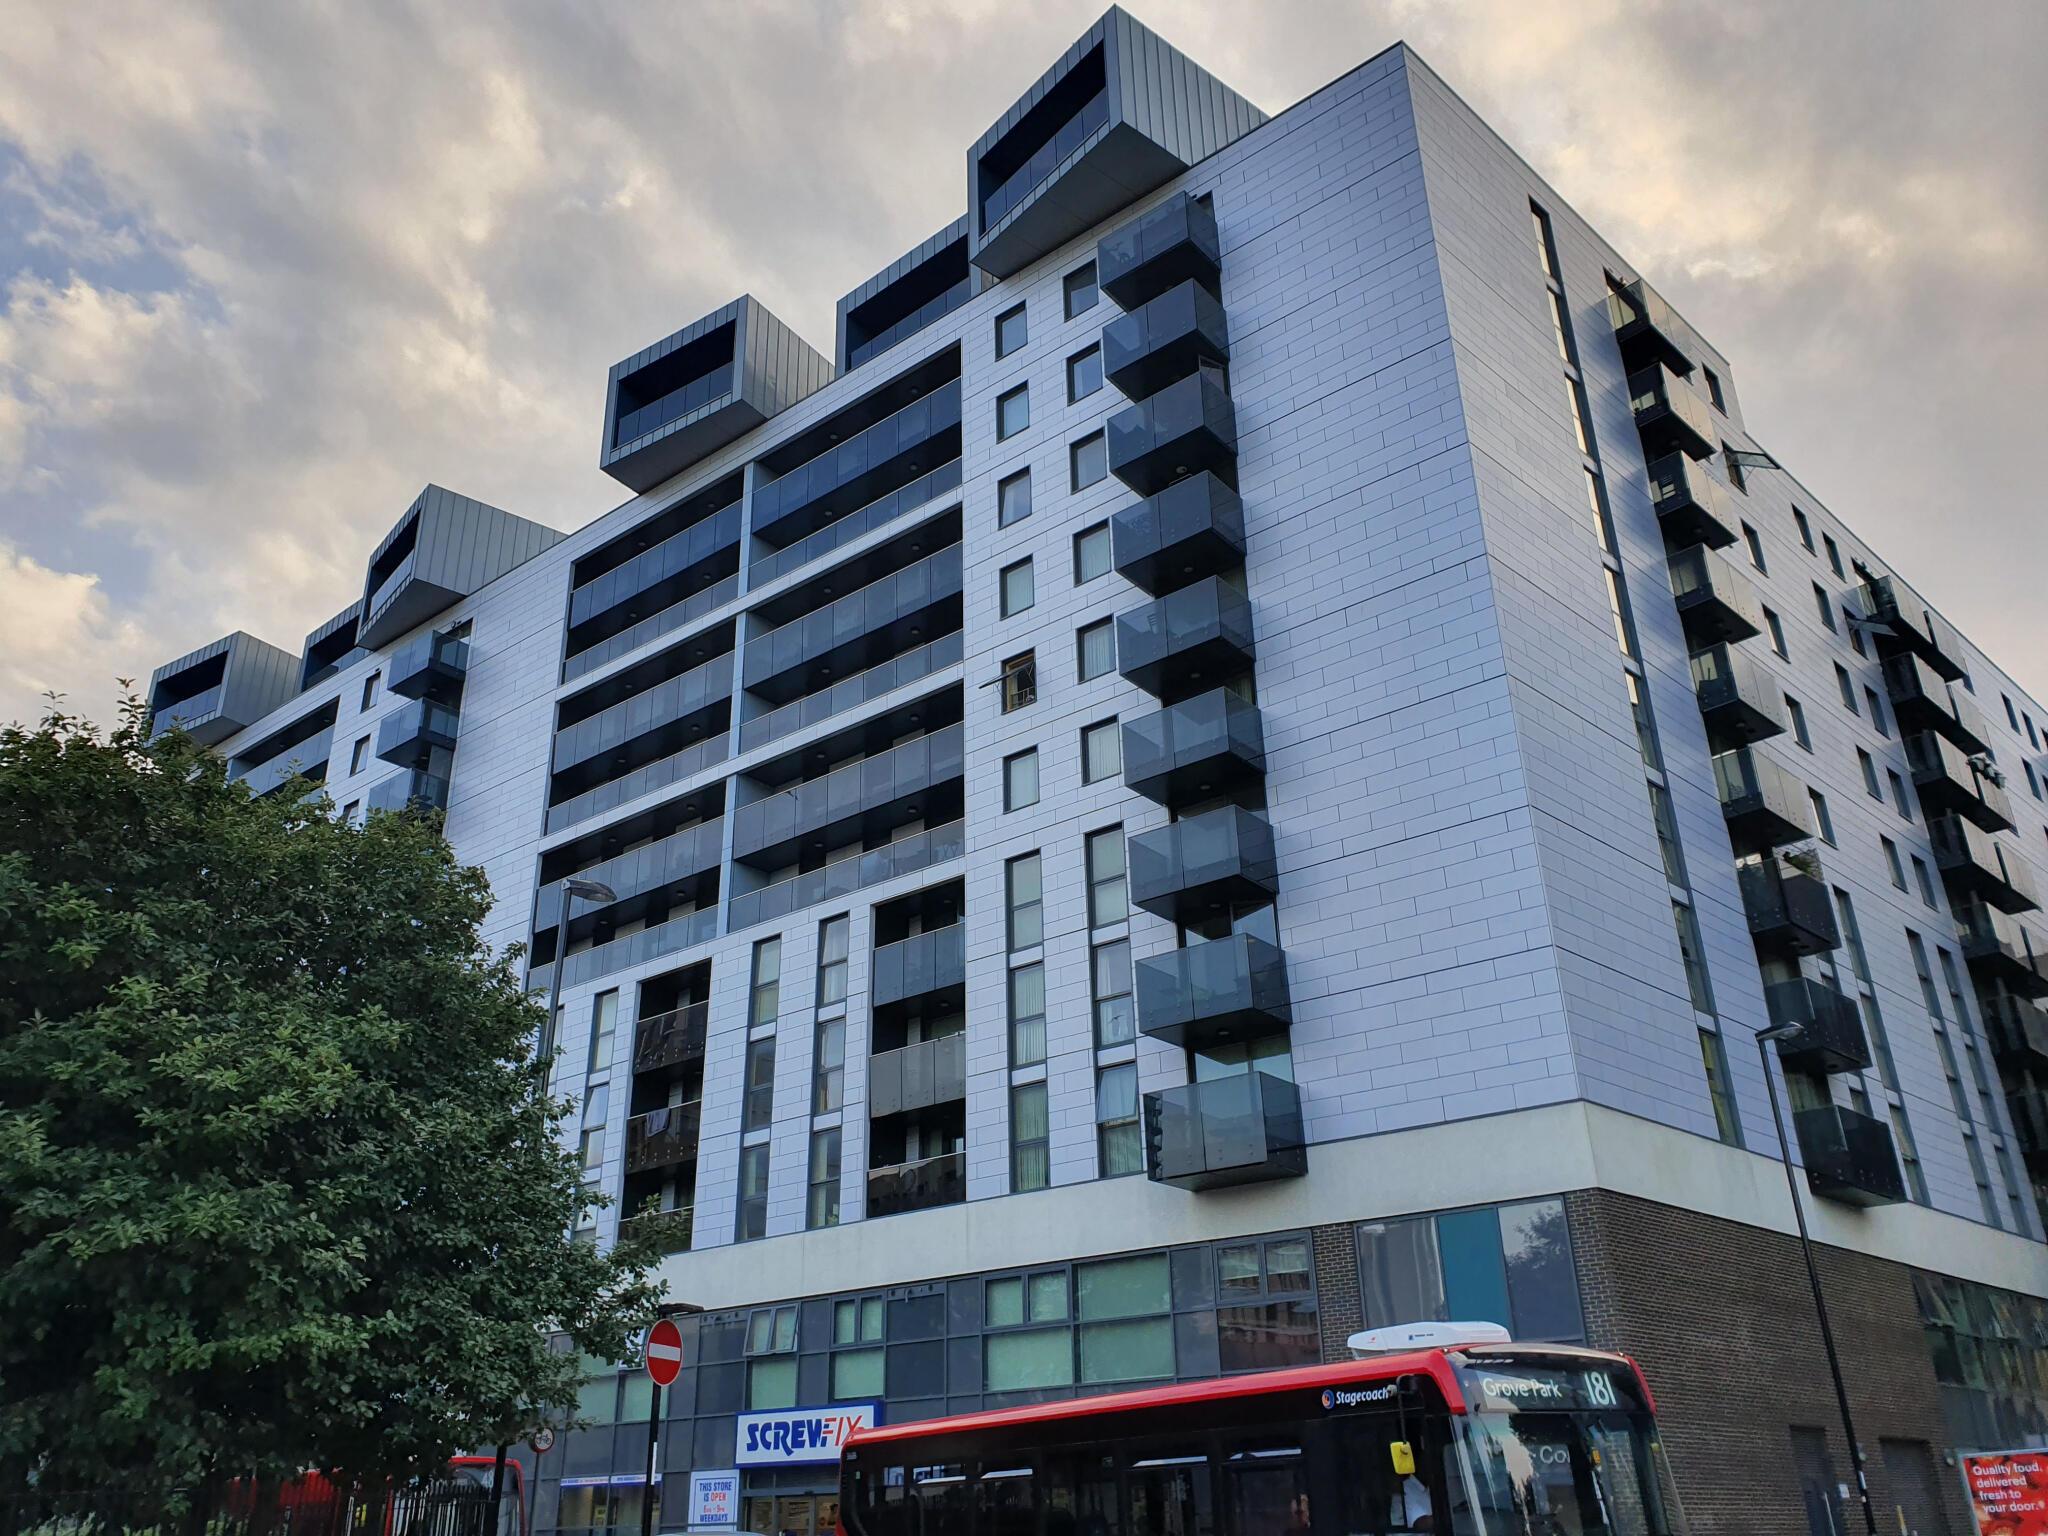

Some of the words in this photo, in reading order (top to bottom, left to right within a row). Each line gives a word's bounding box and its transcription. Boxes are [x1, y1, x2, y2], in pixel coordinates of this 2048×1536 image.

[1482, 1377, 1529, 1397] Grove
[1531, 1378, 1562, 1398] Park
[1584, 1370, 1616, 1405] 181
[1336, 1386, 1389, 1406] Stagecoach
[746, 1415, 864, 1456] SCREWFIX
[1972, 1464, 2011, 1476] Quality
[699, 1482, 712, 1492] THIS
[713, 1481, 732, 1491] STORE
[1976, 1475, 2027, 1488] delivered
[703, 1492, 710, 1501] IS
[711, 1491, 727, 1502] OPEN
[1979, 1489, 2008, 1501] fresh
[2009, 1489, 2022, 1499] to
[1983, 1503, 2006, 1514] your
[700, 1513, 728, 1522] WEEKDAYS
